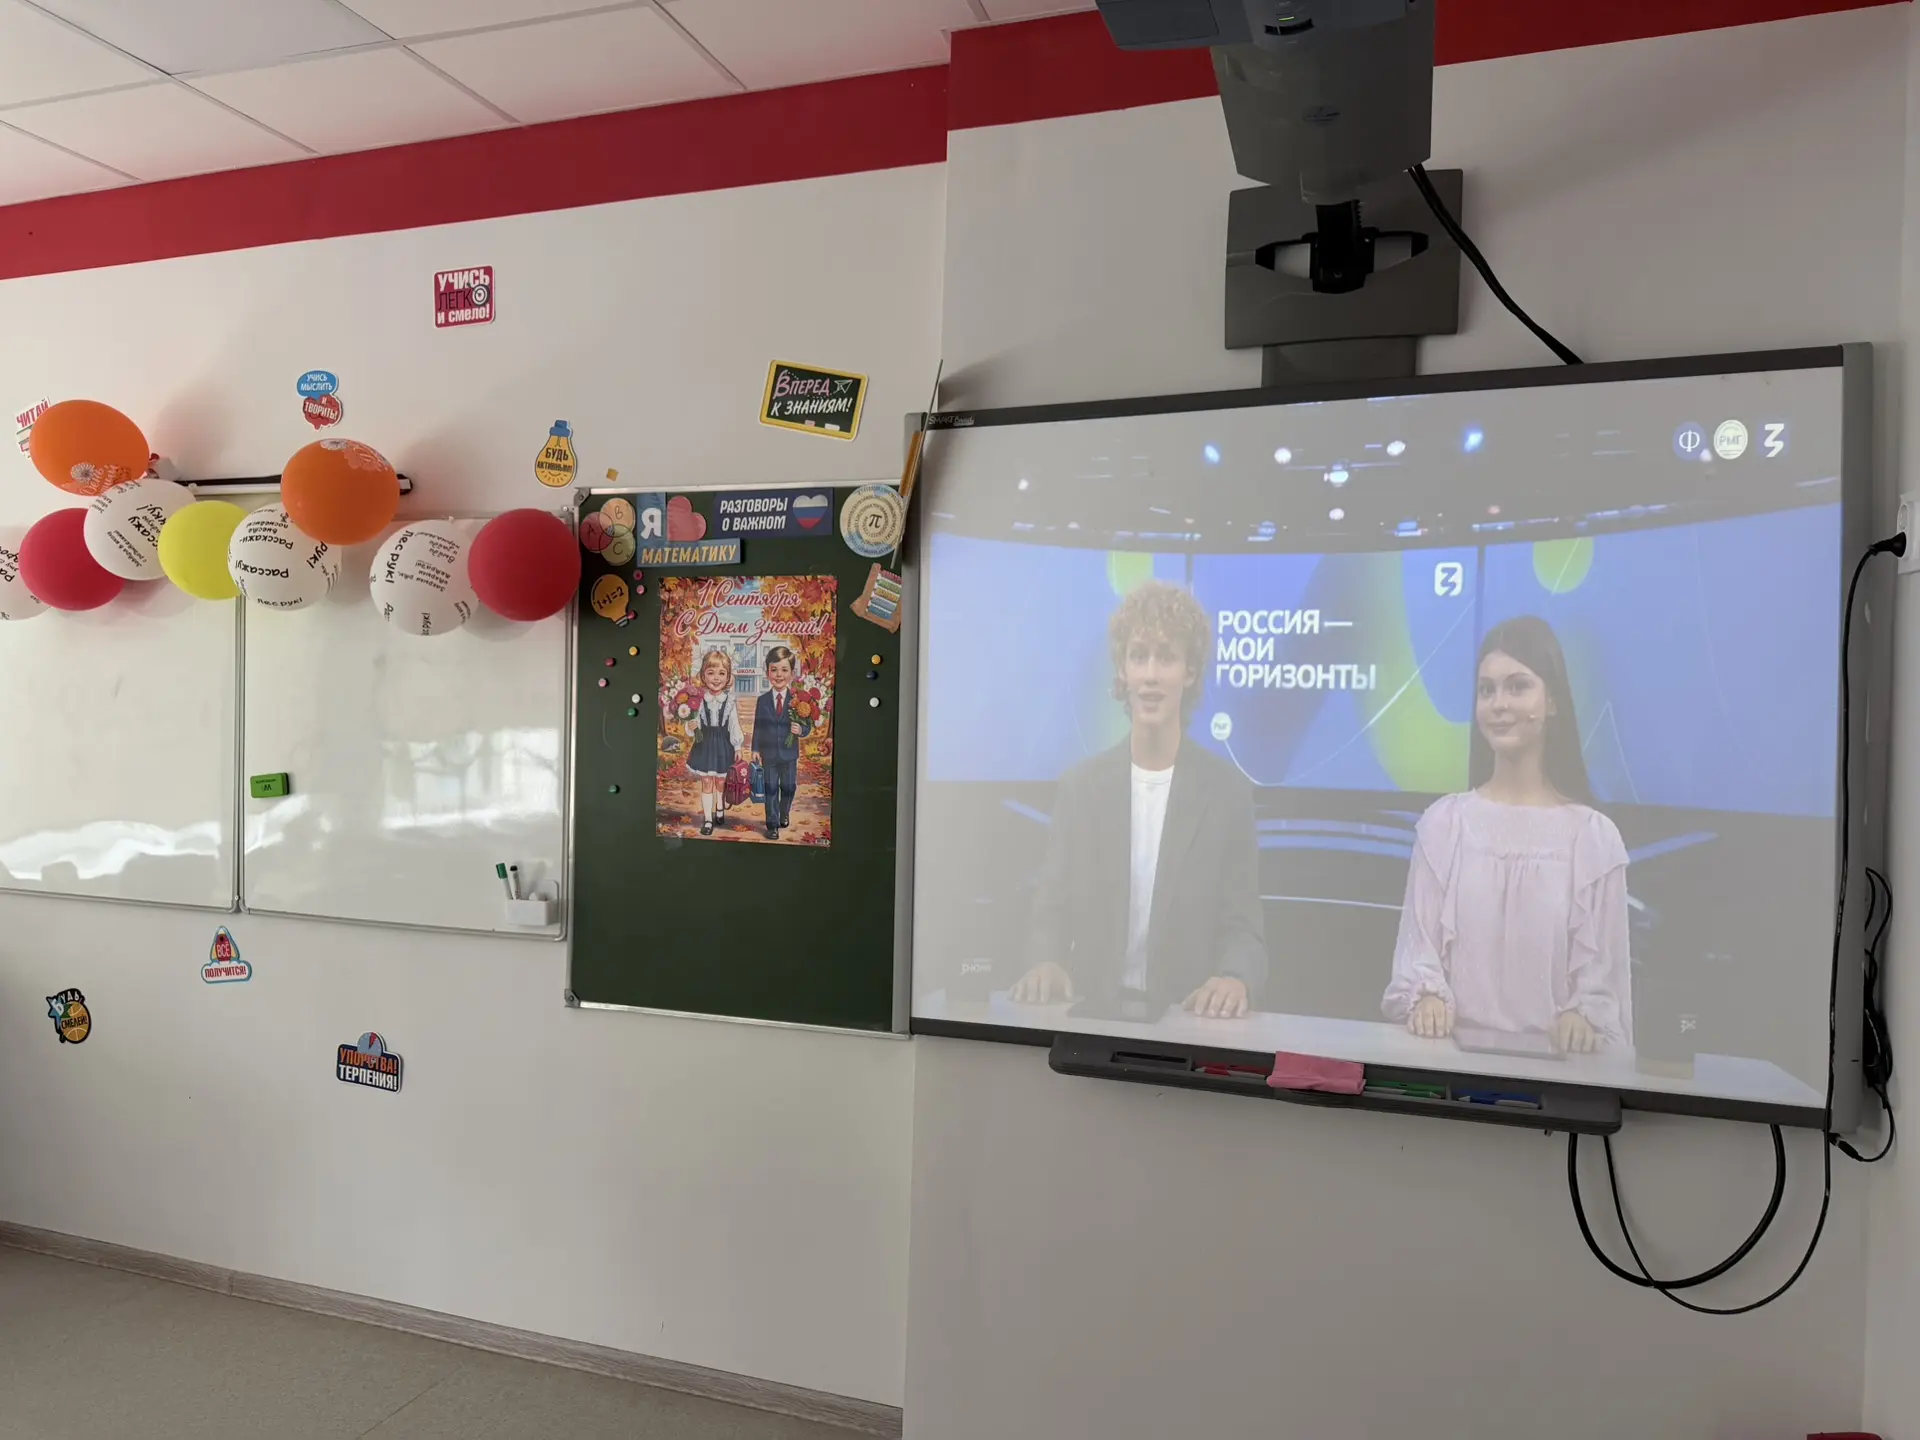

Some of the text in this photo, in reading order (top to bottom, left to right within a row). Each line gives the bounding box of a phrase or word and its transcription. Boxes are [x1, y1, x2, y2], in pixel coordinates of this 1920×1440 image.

[437, 268, 490, 292] УЧИСЬ
[300, 382, 333, 391] МЫСЛИТЬ
[306, 373, 328, 382] УЧИСЬ
[305, 401, 338, 420] ТВОРИТЬ!
[770, 397, 853, 417] К ЗНАНИЯМ!
[545, 447, 569, 462] БУДЬ
[136, 504, 166, 525] чку!
[719, 496, 788, 514] РАЗГОВОРЫ
[127, 515, 158, 550] ссажу
[640, 507, 662, 540] Я
[722, 515, 787, 532] О ВАЖНОМ
[640, 544, 737, 565] МАТЕМАТИКУ
[698, 578, 801, 617] 1 Сентября
[675, 608, 829, 646] С Днем знаний!
[1216, 637, 1275, 662] МОИ
[1215, 663, 1377, 690] ГОРИЗОНТЫ
[204, 965, 247, 979] ПОЛУЧИТСЯ!
[51, 990, 80, 1016] БУДЬ
[61, 1015, 89, 1030] СМЕЛЕЙ!
[340, 1047, 398, 1074] УПОРСТВА!
[339, 1063, 398, 1091] ТЕРПЕНИЯ!
